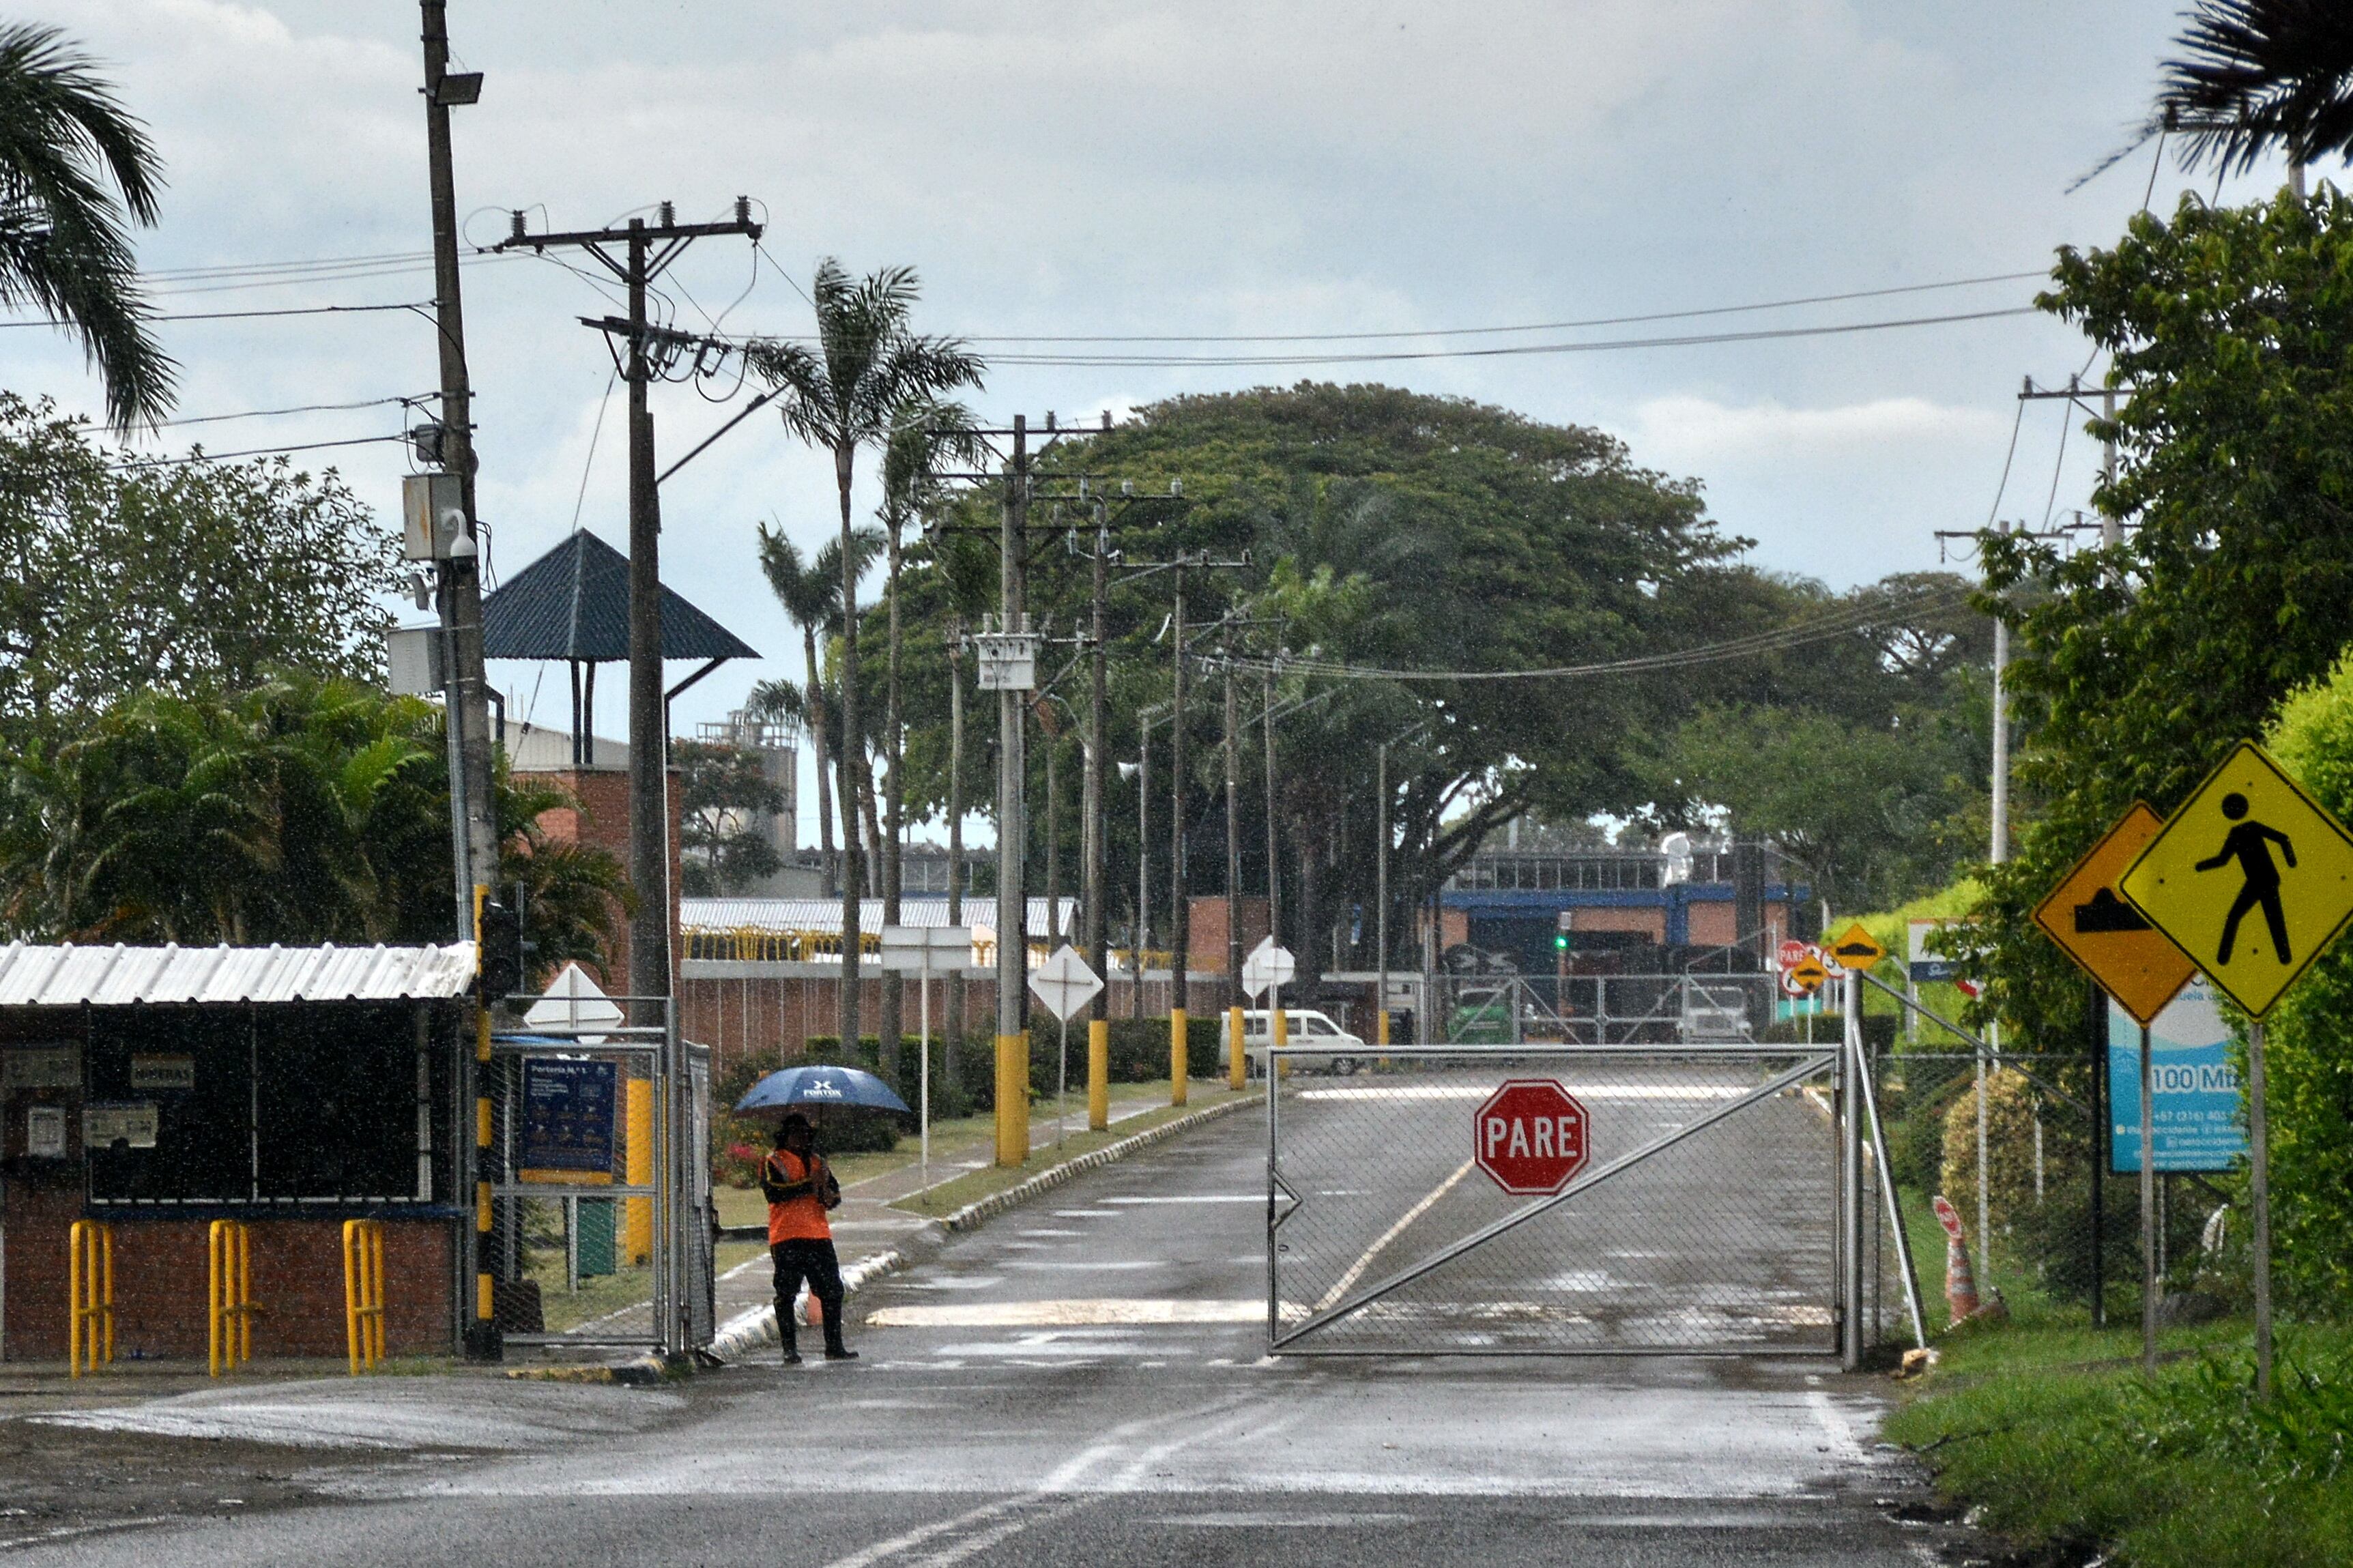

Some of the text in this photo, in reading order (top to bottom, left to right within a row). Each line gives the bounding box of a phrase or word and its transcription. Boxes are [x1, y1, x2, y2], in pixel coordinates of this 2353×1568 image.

[1780, 949, 1805, 962] PARE
[2154, 1068, 2194, 1090] 100
[1487, 1114, 1578, 1159] PARE
